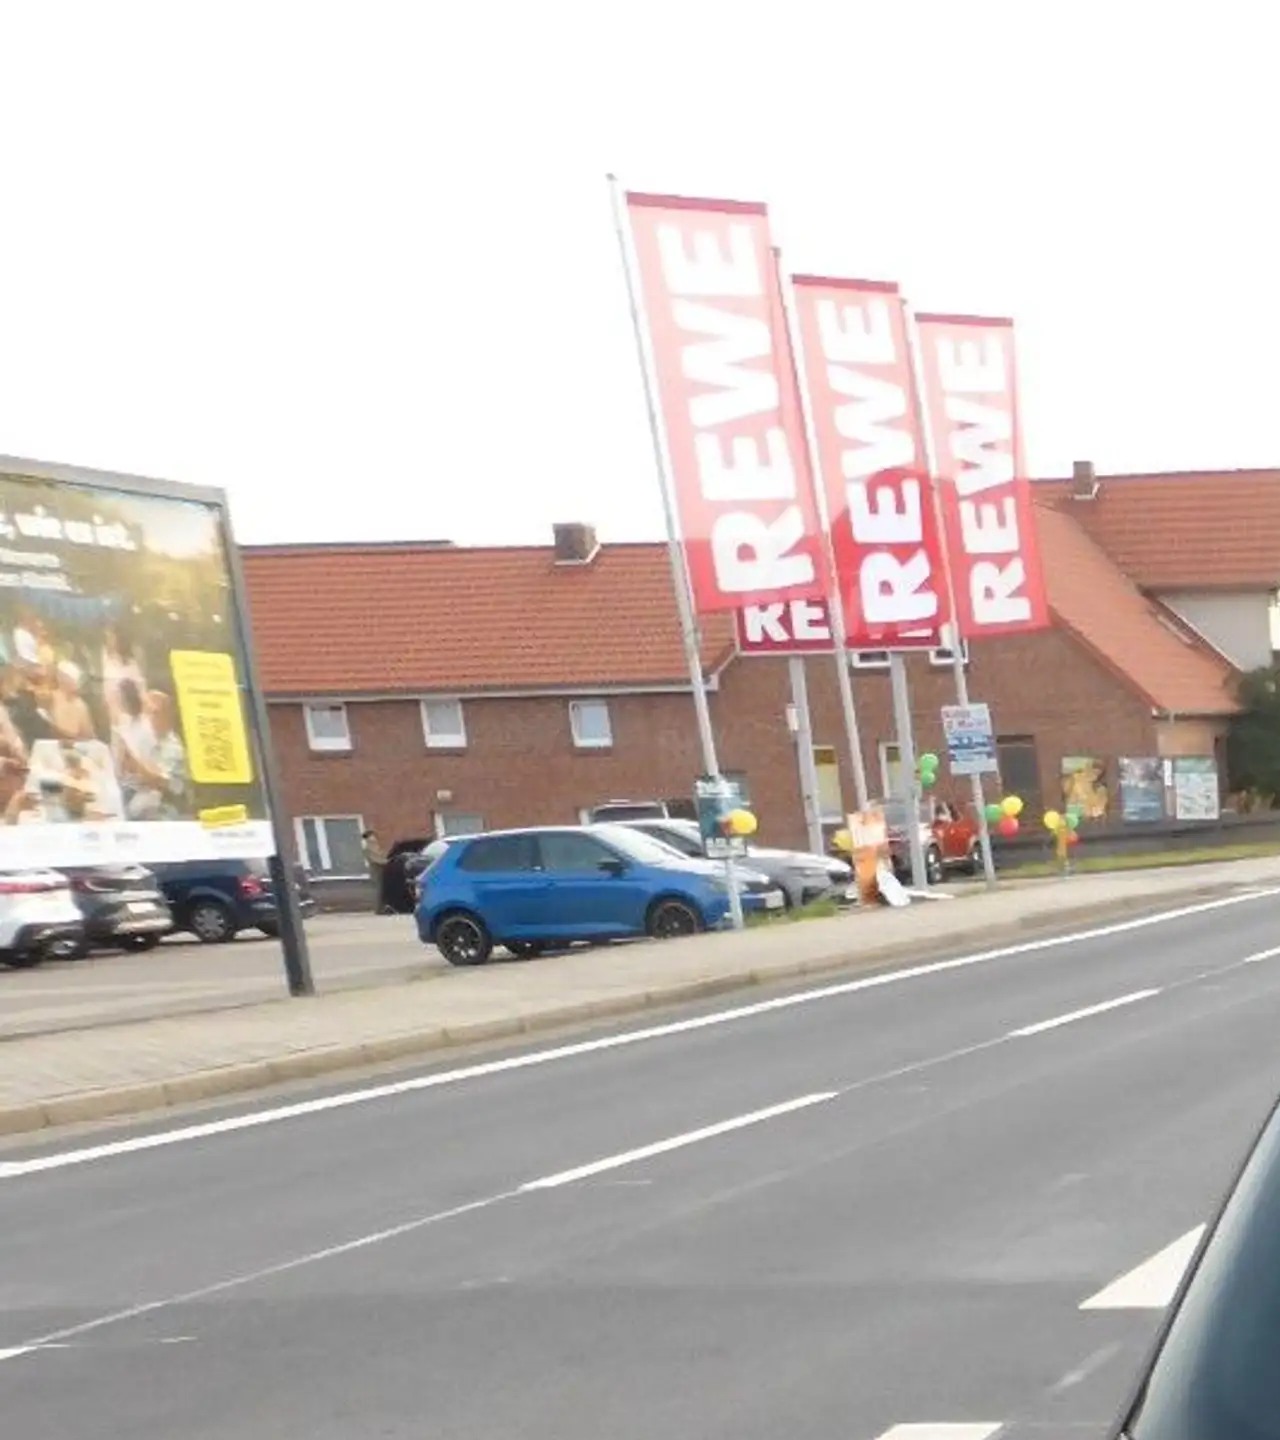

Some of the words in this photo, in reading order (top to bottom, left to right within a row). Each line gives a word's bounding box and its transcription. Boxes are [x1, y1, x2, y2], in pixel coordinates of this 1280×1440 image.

[662, 223, 815, 592] REWE
[817, 296, 936, 624] REWE
[941, 336, 1031, 624] REWE
